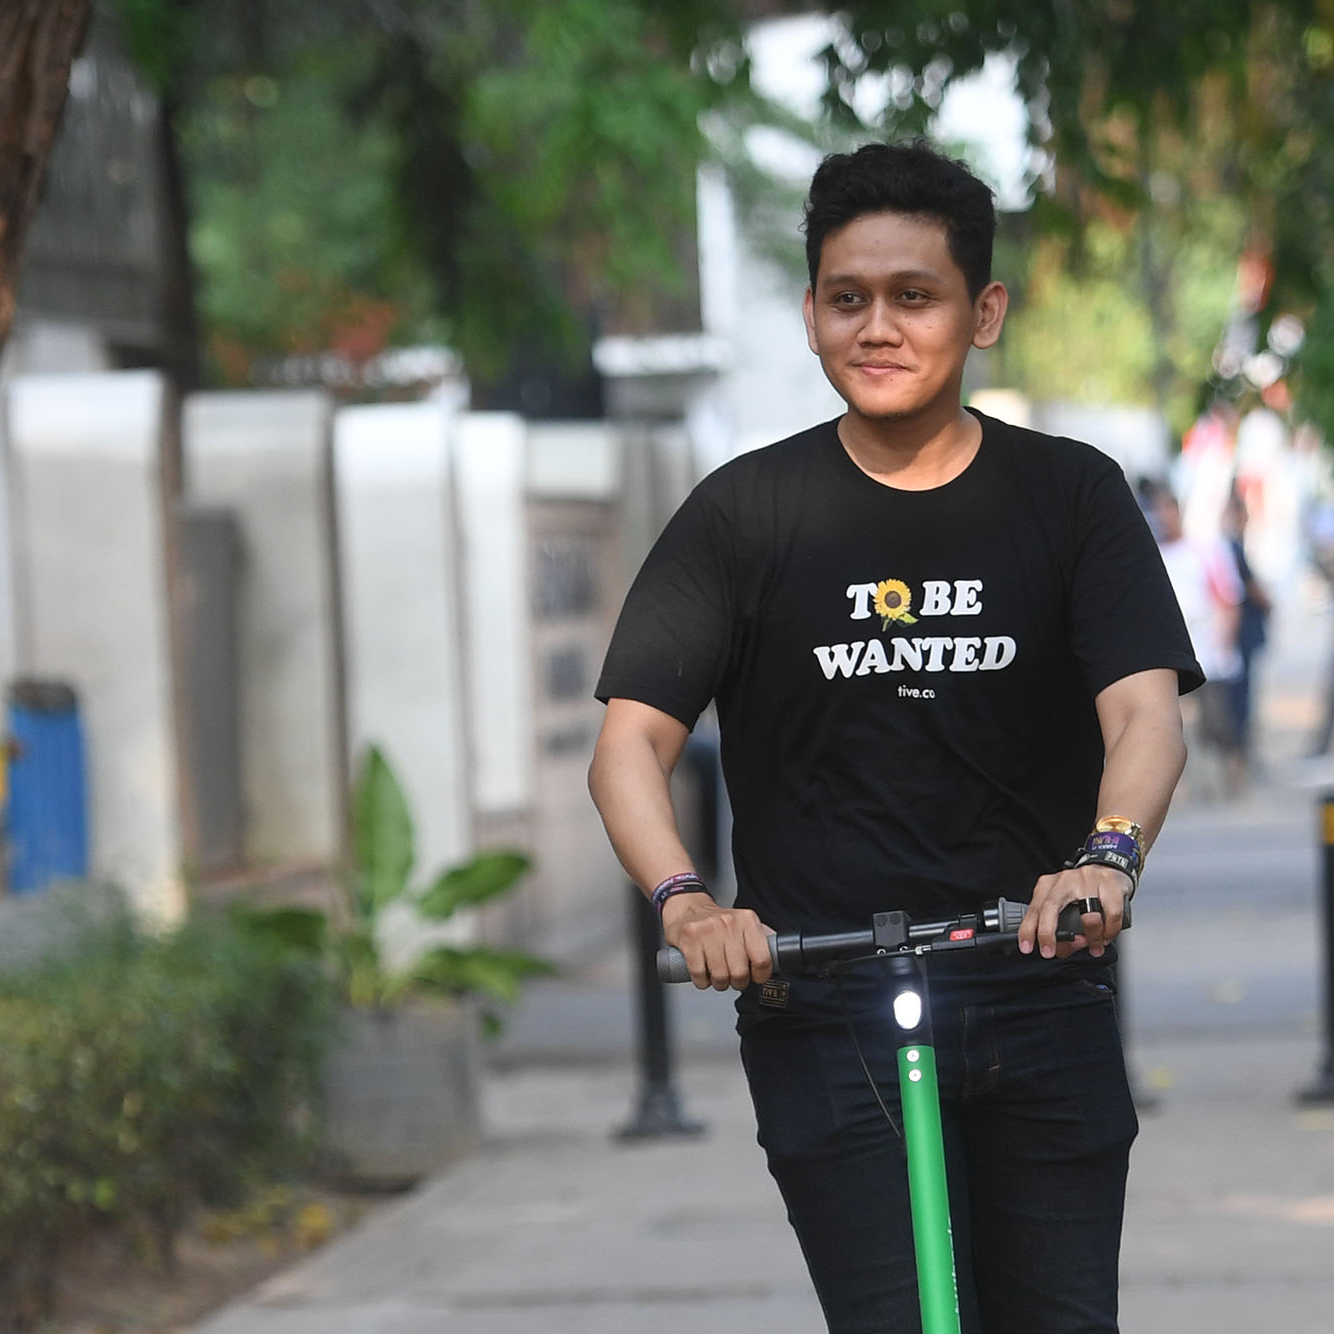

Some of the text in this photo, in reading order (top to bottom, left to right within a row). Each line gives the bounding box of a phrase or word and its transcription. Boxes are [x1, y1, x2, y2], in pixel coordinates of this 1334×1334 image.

[920, 579, 983, 616] BE
[813, 635, 1017, 681] WANTED
[898, 684, 935, 699] tive.co
